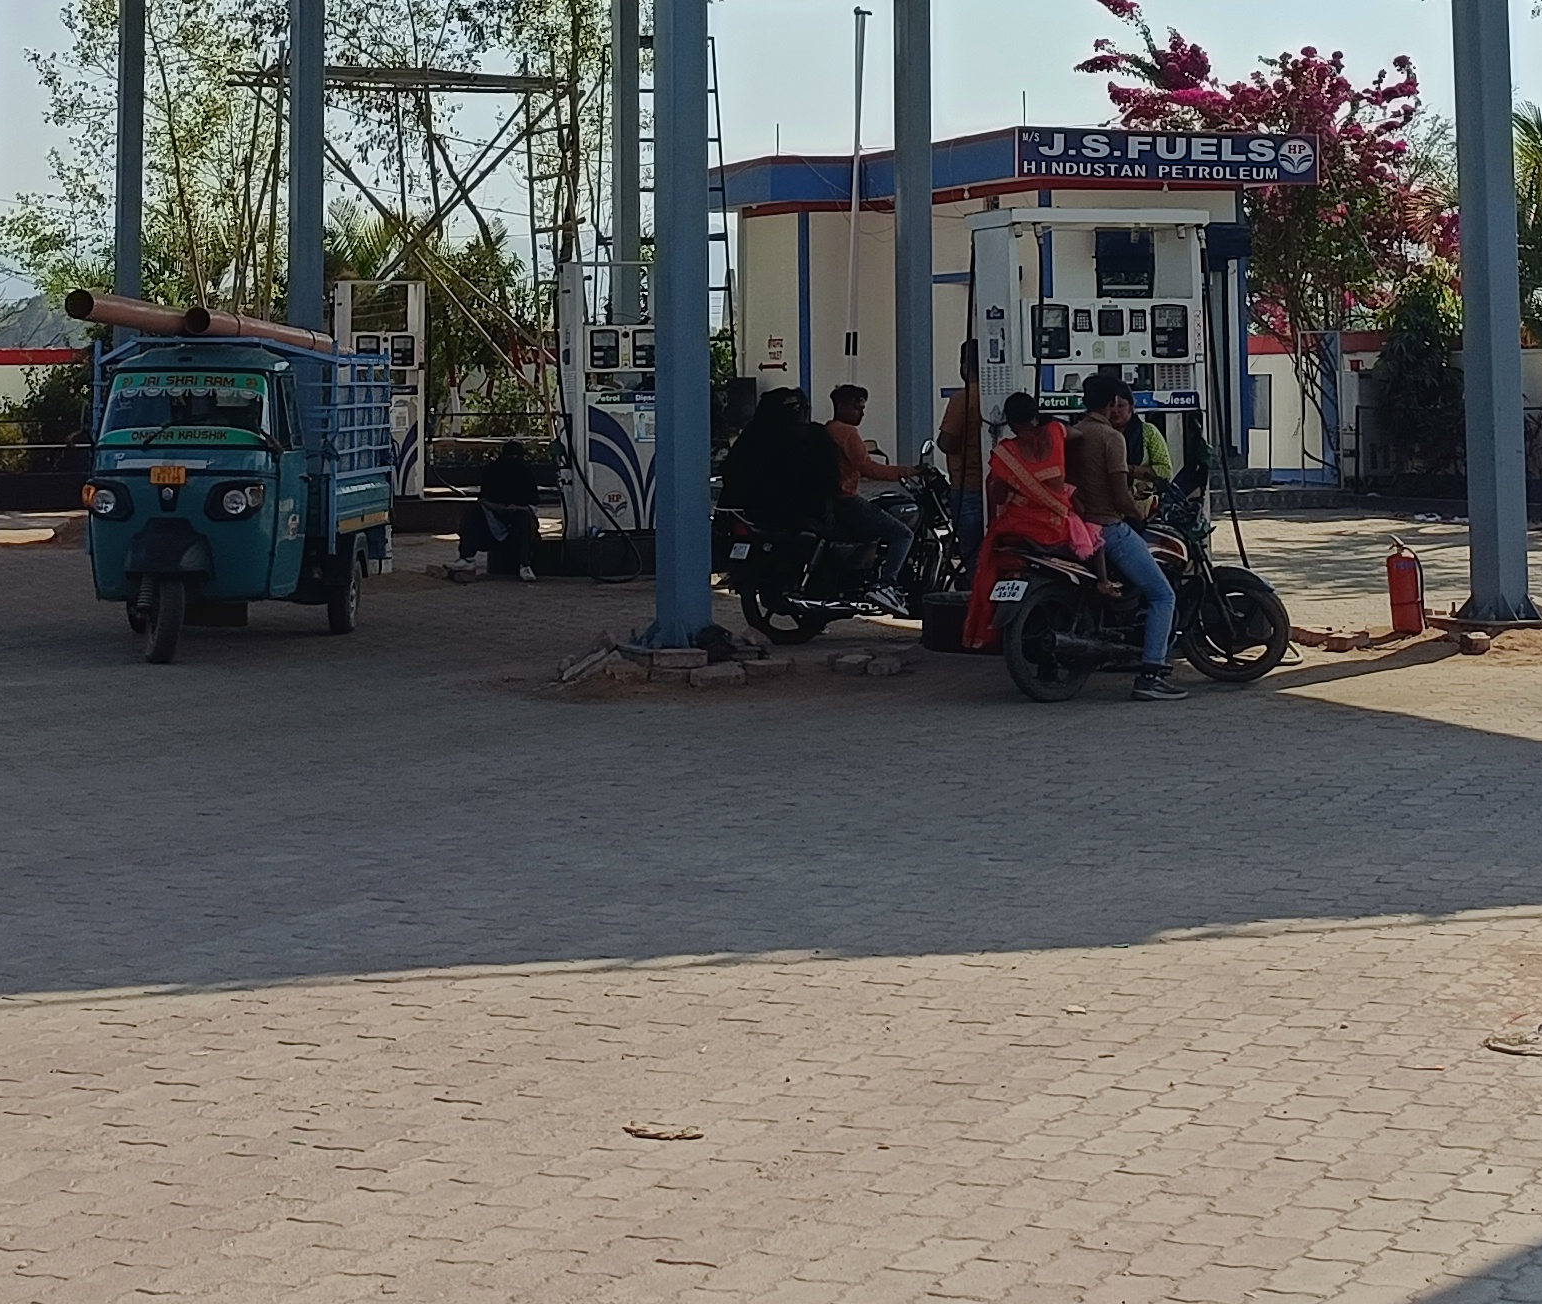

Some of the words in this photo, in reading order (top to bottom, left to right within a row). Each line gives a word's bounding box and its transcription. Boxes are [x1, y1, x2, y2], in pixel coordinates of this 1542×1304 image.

[1022, 132, 1040, 143] M/S
[1287, 144, 1306, 155] HP
[1023, 160, 1147, 178] HINDUSTAN
[1159, 165, 1279, 181] PETROLEUM
[140, 376, 160, 386] JAI
[165, 375, 198, 386] SHRI
[203, 376, 236, 387] RAM
[1038, 397, 1069, 407] Petrol
[178, 429, 228, 441] KAUSHIK
[608, 494, 622, 503] HP
